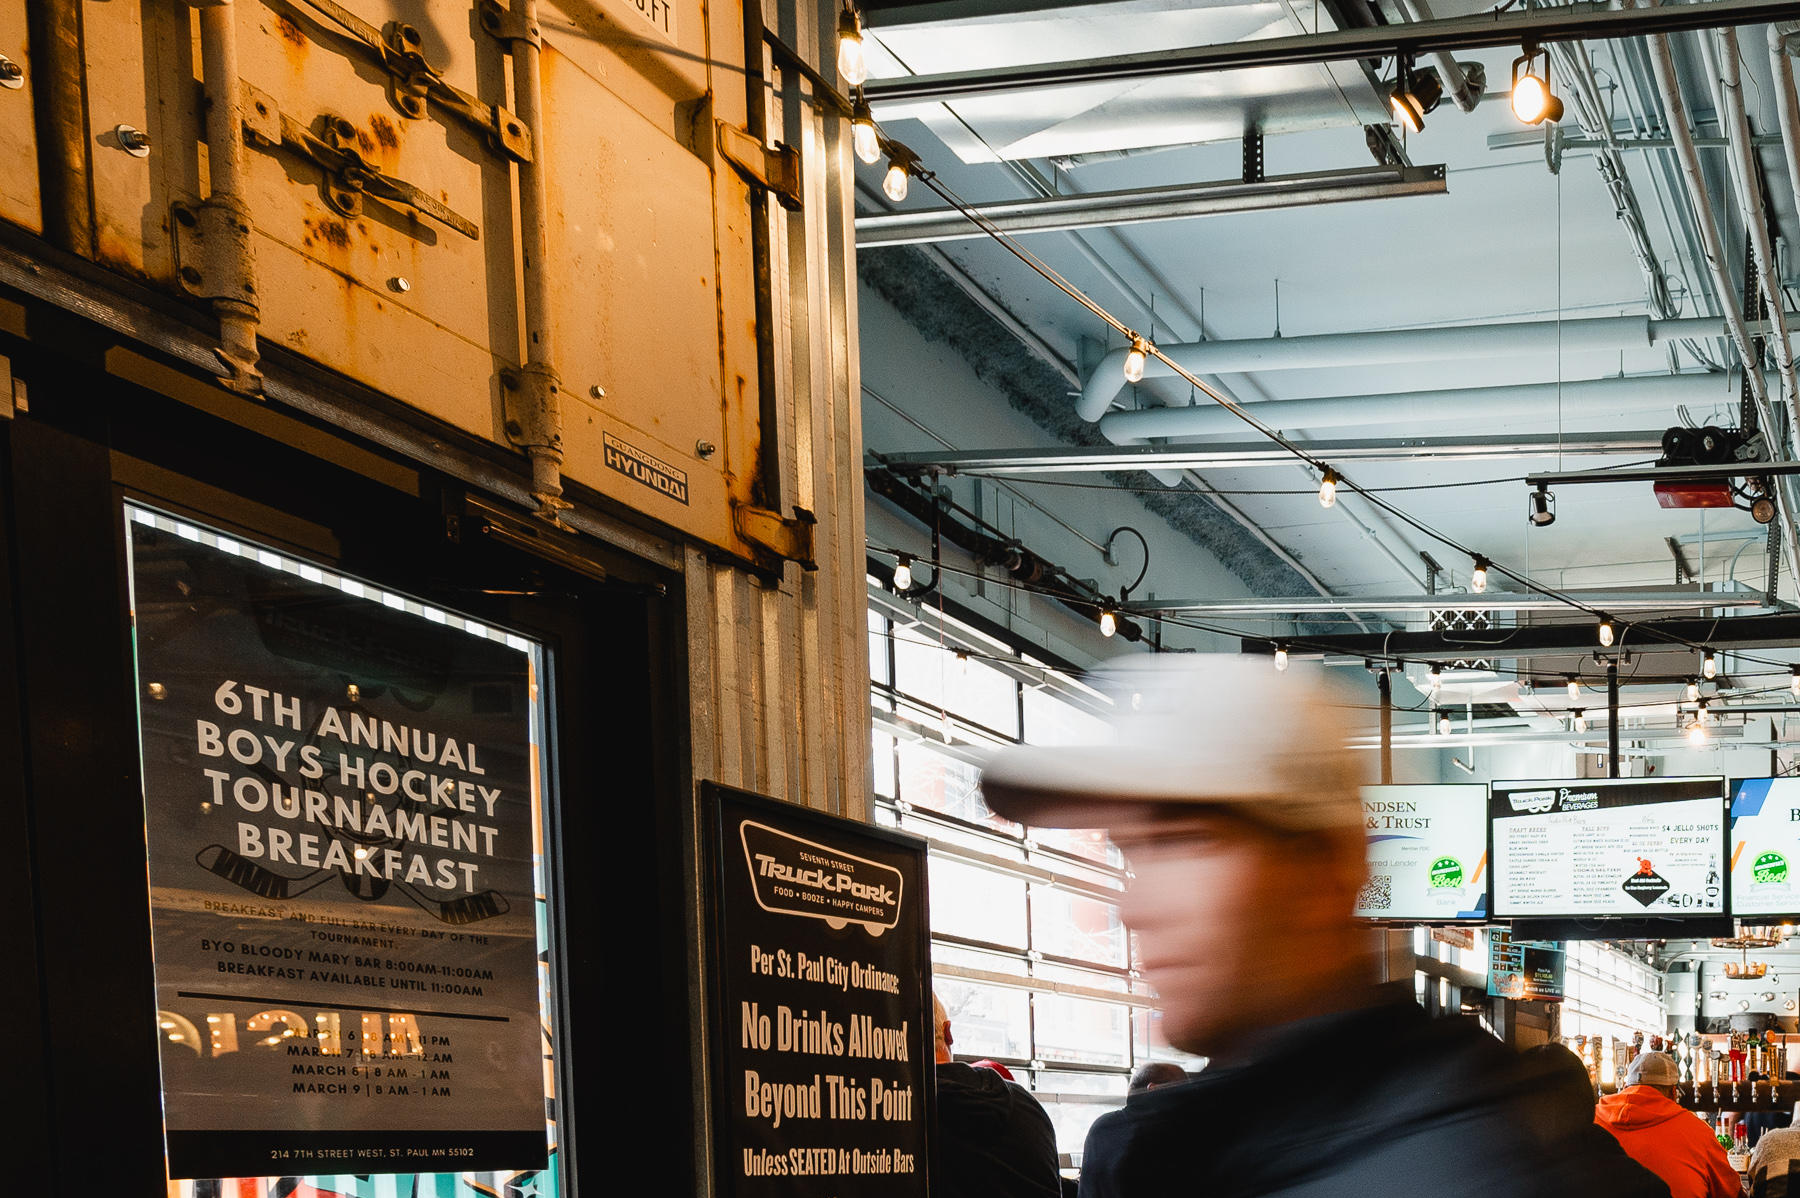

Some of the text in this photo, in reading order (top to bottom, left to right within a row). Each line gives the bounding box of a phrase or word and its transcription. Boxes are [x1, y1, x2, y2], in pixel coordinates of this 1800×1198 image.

[607, 448, 686, 501] HYUNDAI
[611, 439, 680, 479] GUANGDONG
[215, 680, 484, 775] 6TH ANNUAL
[197, 720, 501, 817] BOYS HOCKEY
[204, 768, 499, 857] TOURNAMENT
[1360, 801, 1417, 813] NDSEN
[1559, 788, 1598, 806] Premium
[1561, 801, 1598, 811] BEVERAGES
[1366, 815, 1431, 829] & TRUST
[238, 822, 479, 893] BREAKFAST
[800, 852, 854, 873] SEVENTH STREET
[755, 853, 896, 906] Truck Park
[1755, 869, 1787, 883] Best
[774, 885, 884, 917] FOOD BOOZE HAPPY CAMPERS
[204, 900, 489, 945] BREAKFAST AND FULL BAR EVERY DAY OF THE
[202, 939, 493, 980] BYO BLOODY MARY BAR 8:00AM-11:00AM
[751, 944, 900, 995] Per St. Paul City Ordinance:
[218, 961, 483, 996] BREAKFAST AVAILABLE UNTIL 11:00AM
[348, 1031, 356, 1041] 6
[370, 1031, 378, 1042] 8
[383, 1032, 405, 1043] AM
[431, 1036, 450, 1046] PM
[742, 1001, 909, 1062] No Drinks Allowed
[287, 1045, 453, 1063] MARCH 7 8 AM 12 AM
[291, 1064, 346, 1076] MARCH
[374, 1066, 382, 1077] 8
[387, 1067, 408, 1078] AM
[430, 1069, 450, 1080] AM
[292, 1083, 347, 1094] MARCH
[353, 1085, 360, 1094] 9
[376, 1085, 383, 1095] 8
[388, 1085, 409, 1095] AM
[431, 1086, 451, 1097] AM
[745, 1069, 912, 1129] Beyond This Point
[271, 1150, 289, 1159] 214
[294, 1149, 314, 1158] 7TH
[317, 1149, 354, 1158] STREET
[407, 1148, 429, 1157] PAUL
[432, 1148, 445, 1157] MN
[448, 1148, 474, 1157] 55102
[743, 1148, 915, 1176] Unless SEATED At Outside Bars
